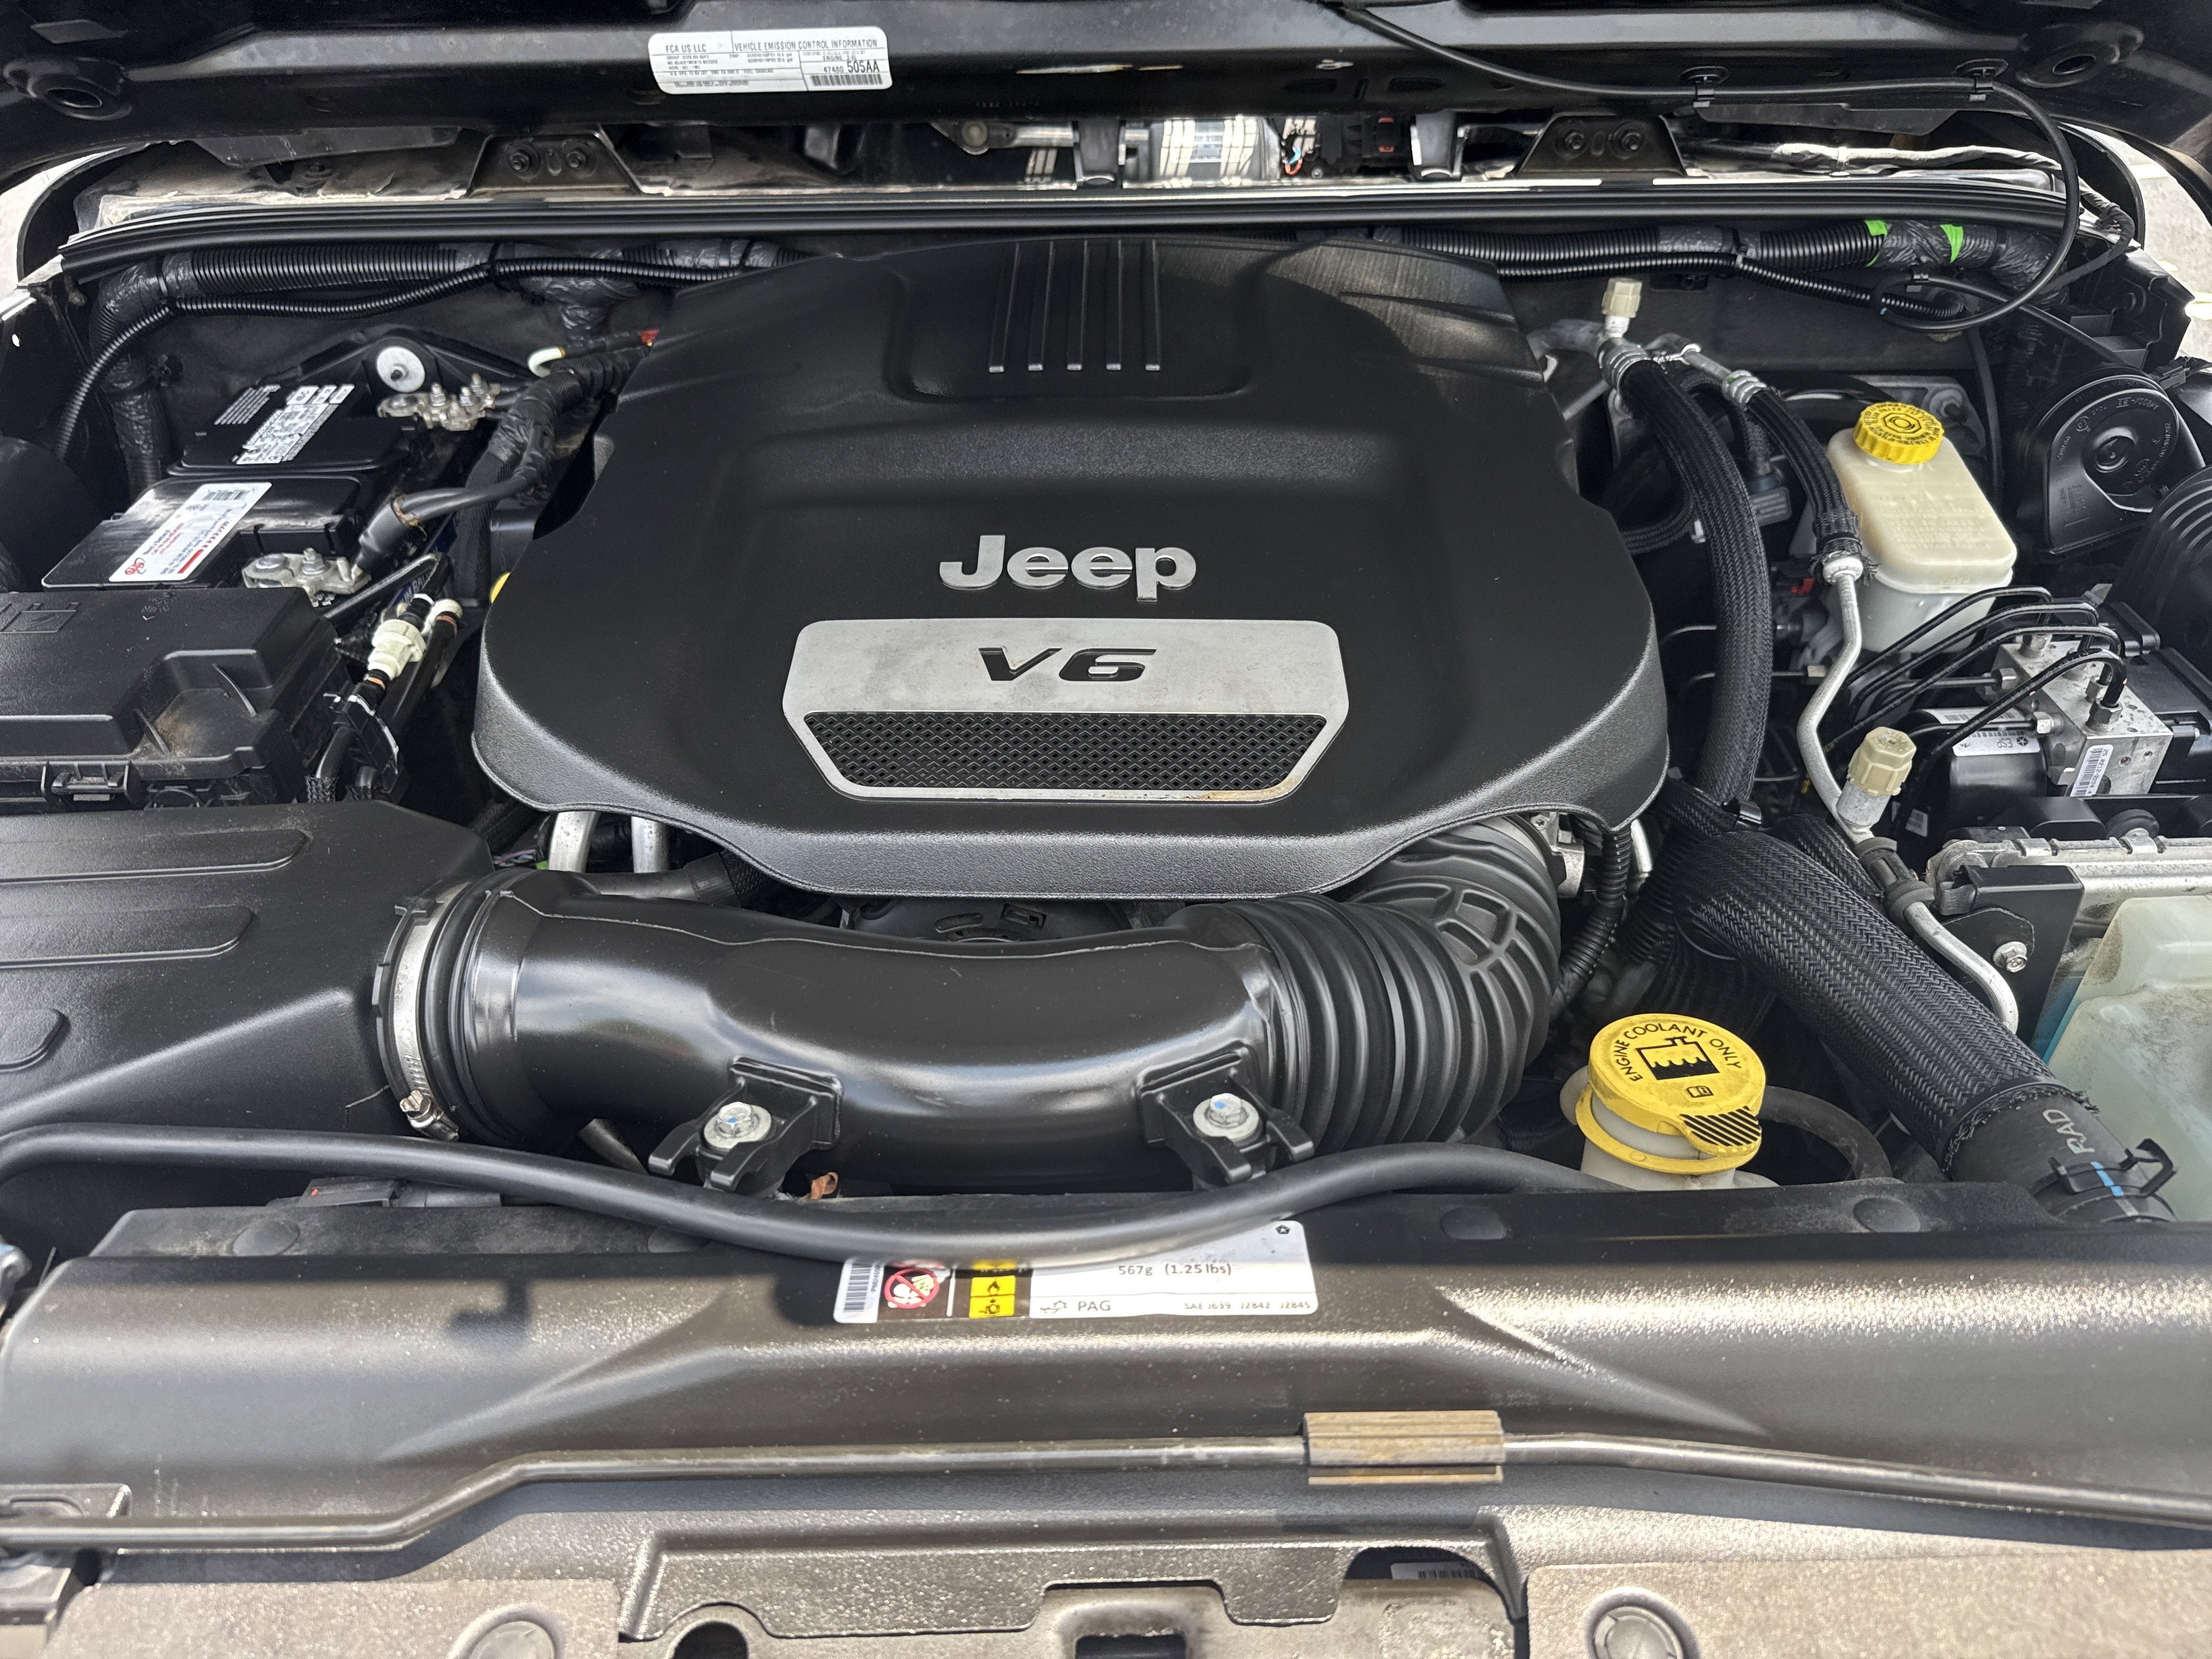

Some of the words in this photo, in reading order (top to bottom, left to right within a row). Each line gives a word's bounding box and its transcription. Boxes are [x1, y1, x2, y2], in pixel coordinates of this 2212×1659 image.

[665, 44, 680, 53] FCA
[681, 44, 691, 53] US
[693, 44, 707, 53] LLC
[734, 43, 762, 52] VEHICLE
[764, 41, 796, 50] EMISSION
[798, 40, 829, 49] CONTROL
[831, 39, 877, 48] INFORMATION
[847, 60, 880, 73] 505AA
[939, 535, 1198, 602] Jeep
[978, 647, 1157, 682] V6
[1996, 738, 2013, 748] ESP
[1623, 1023, 1708, 1040] COOLANT
[1709, 1037, 1743, 1069] ONLY
[1613, 1039, 1644, 1082] ENGINE
[2042, 1109, 2095, 1154] RAD
[1118, 1264, 1154, 1277] 567g
[1205, 1263, 1232, 1276] lbs)
[1077, 1300, 1112, 1312] PAG
[1184, 1302, 1204, 1310] SAE
[1240, 1302, 1271, 1310] J2842
